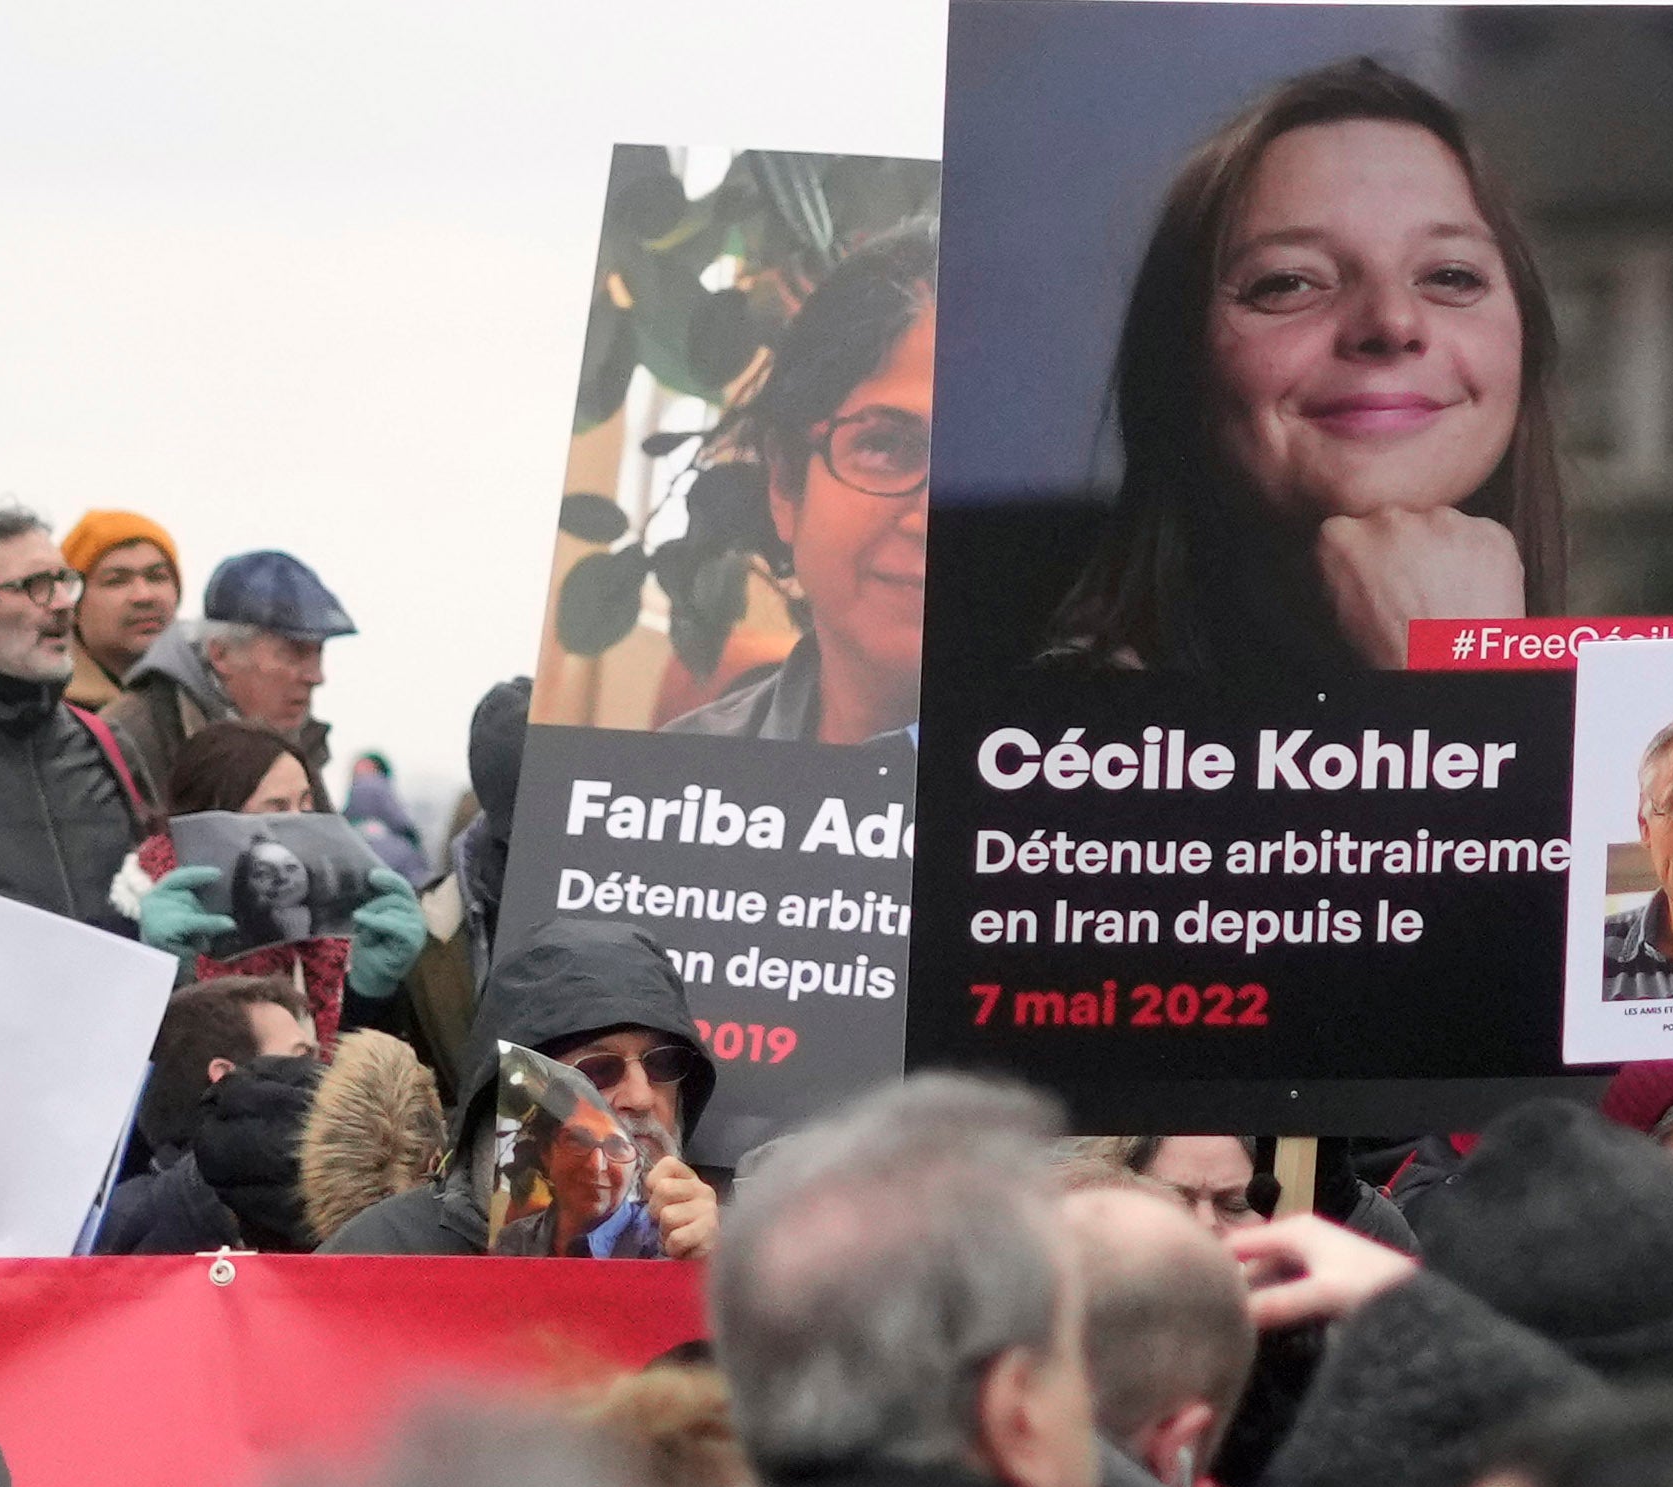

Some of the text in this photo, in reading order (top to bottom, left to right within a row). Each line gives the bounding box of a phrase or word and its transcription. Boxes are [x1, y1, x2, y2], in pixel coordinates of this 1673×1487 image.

[977, 726, 1516, 792] Cécile Kohler
[567, 780, 786, 850] Fariba
[976, 829, 1571, 876] Détenue arbitraireme
[557, 869, 767, 922] Détenue
[970, 899, 1422, 953] en Iran depuis le
[726, 947, 896, 1001] depuis
[970, 980, 1269, 1026] 7 mai 2022
[1624, 1008, 1638, 1016] LES
[1640, 1006, 1662, 1015] AMIS
[1664, 1006, 1673, 1014] ET
